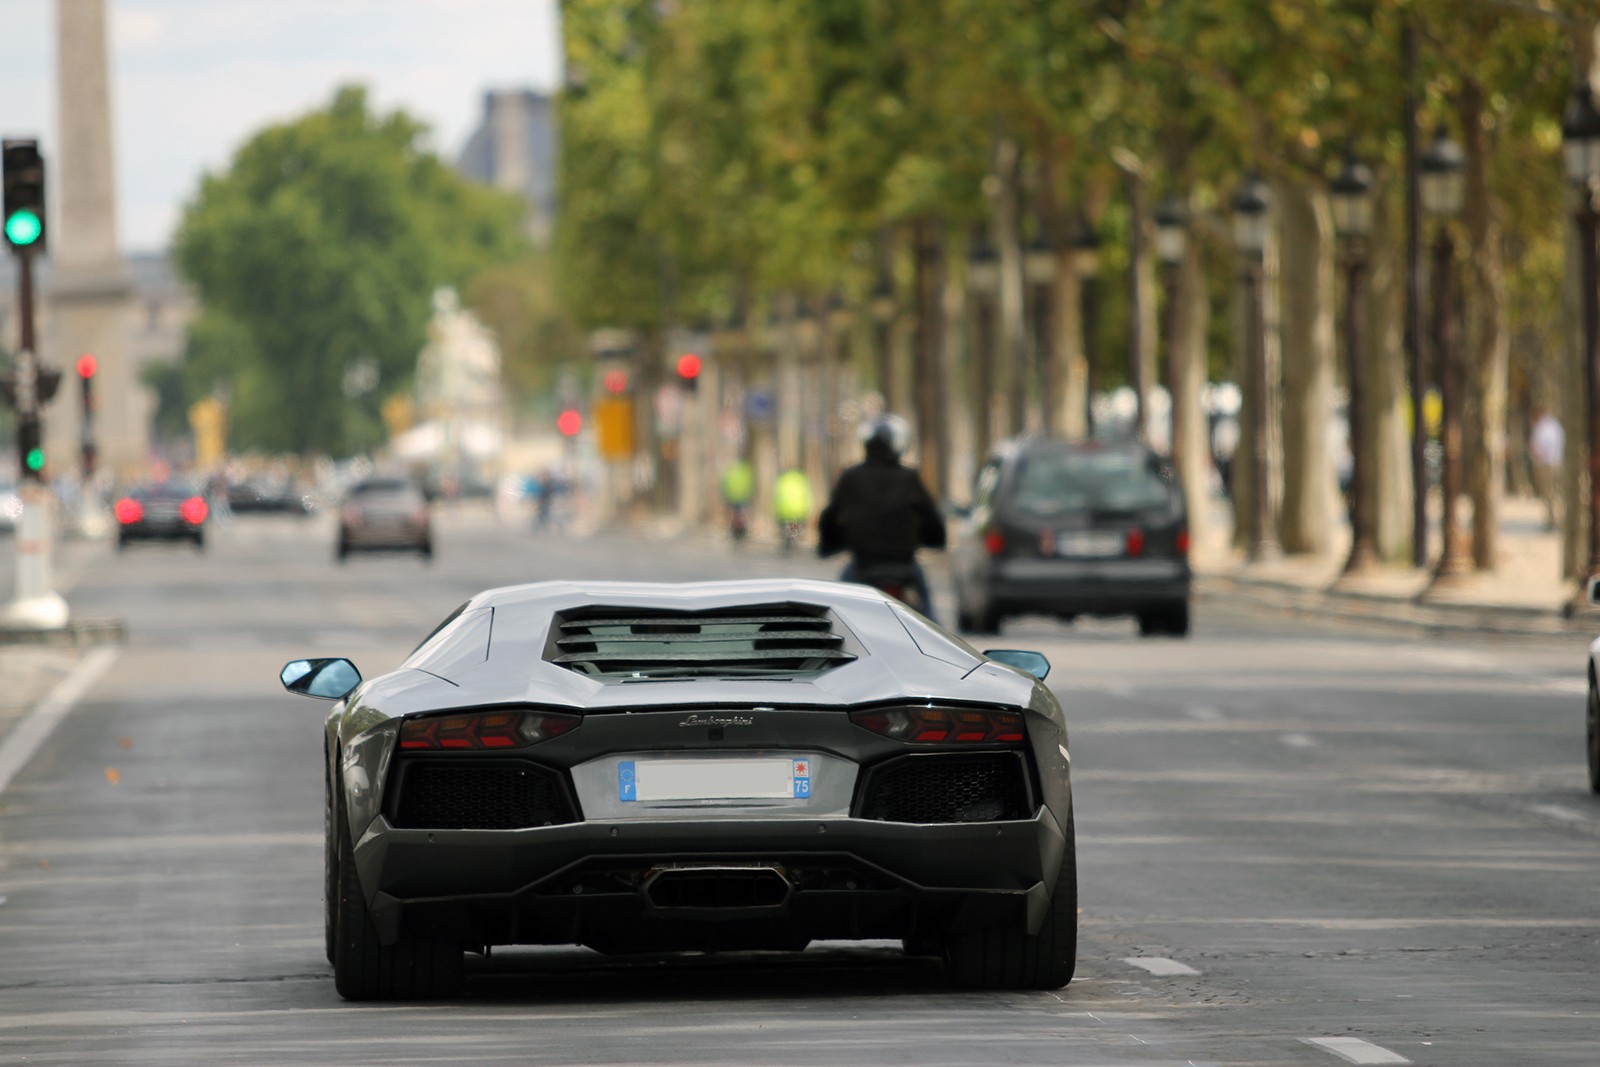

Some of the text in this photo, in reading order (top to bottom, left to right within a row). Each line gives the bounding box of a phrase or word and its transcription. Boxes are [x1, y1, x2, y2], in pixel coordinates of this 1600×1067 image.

[679, 714, 753, 728] Lamborghini
[624, 784, 631, 794] F
[795, 780, 809, 793] 75
